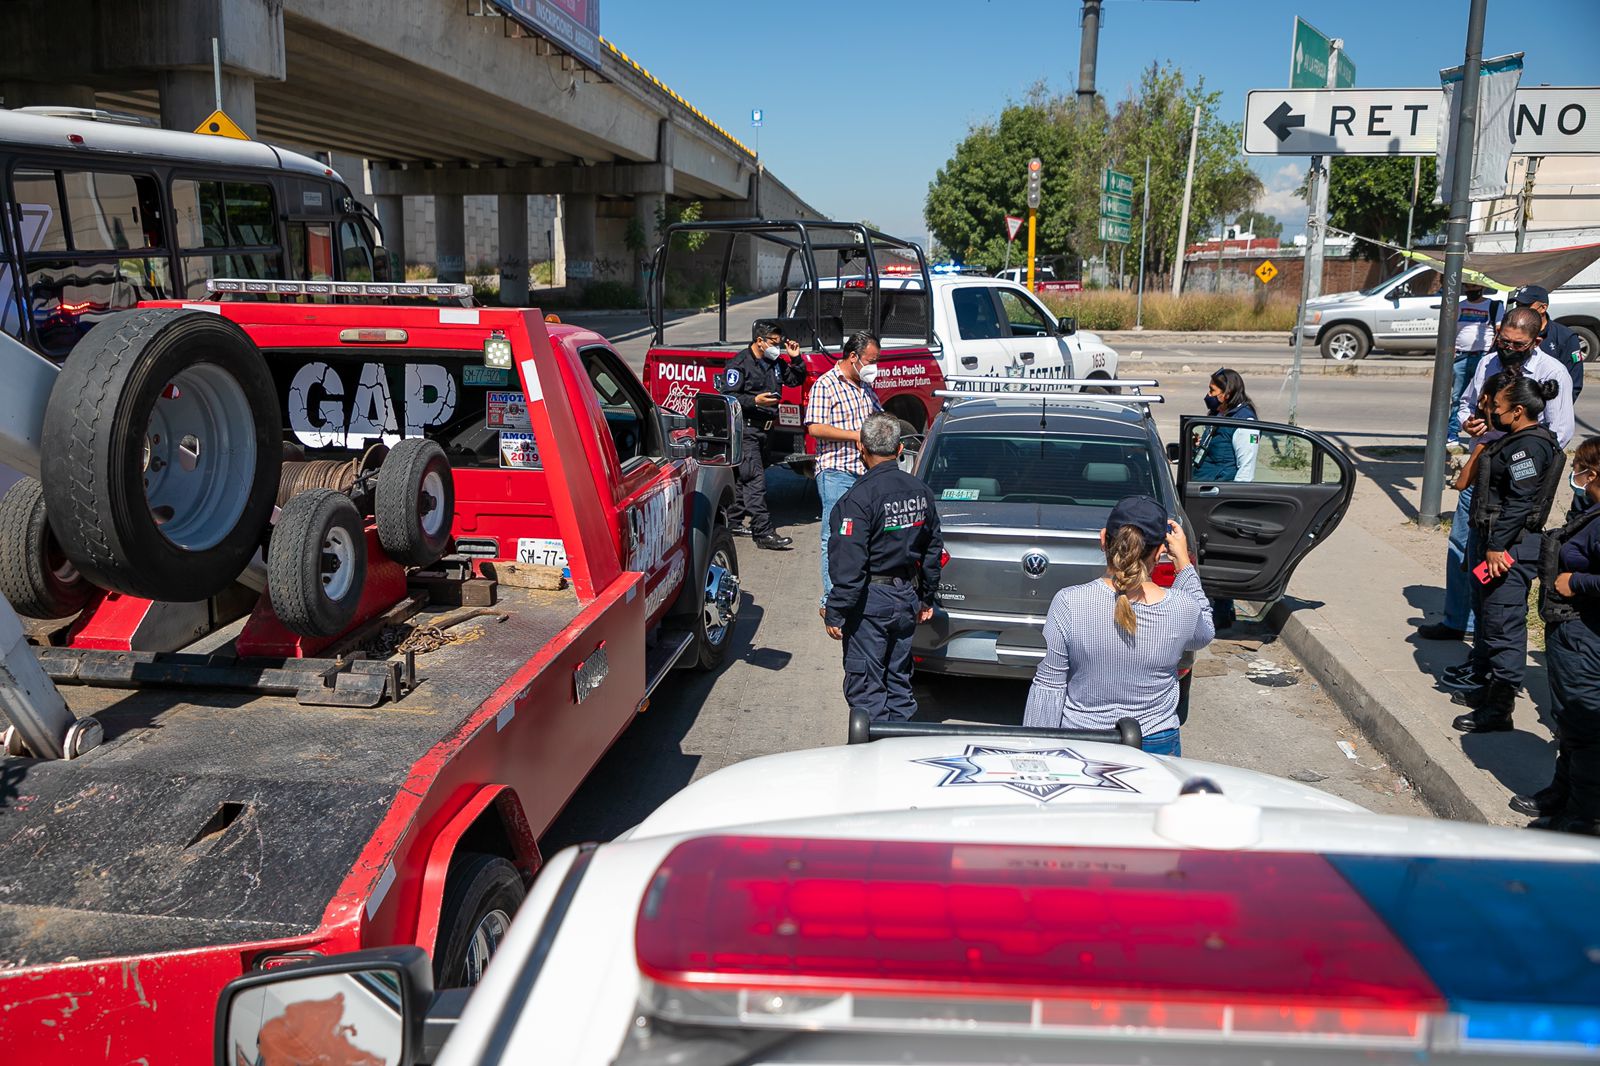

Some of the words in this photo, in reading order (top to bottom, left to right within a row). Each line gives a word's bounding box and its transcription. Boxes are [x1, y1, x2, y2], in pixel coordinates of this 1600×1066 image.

[1329, 103, 1587, 137] RETNO
[902, 364, 926, 376] Puebla
[288, 361, 457, 449] GAP
[490, 394, 526, 402] AMOT
[502, 432, 536, 440] AMOT
[510, 452, 539, 462] 2019
[884, 496, 928, 516] POLICÍA
[884, 511, 926, 528] ESTATAL
